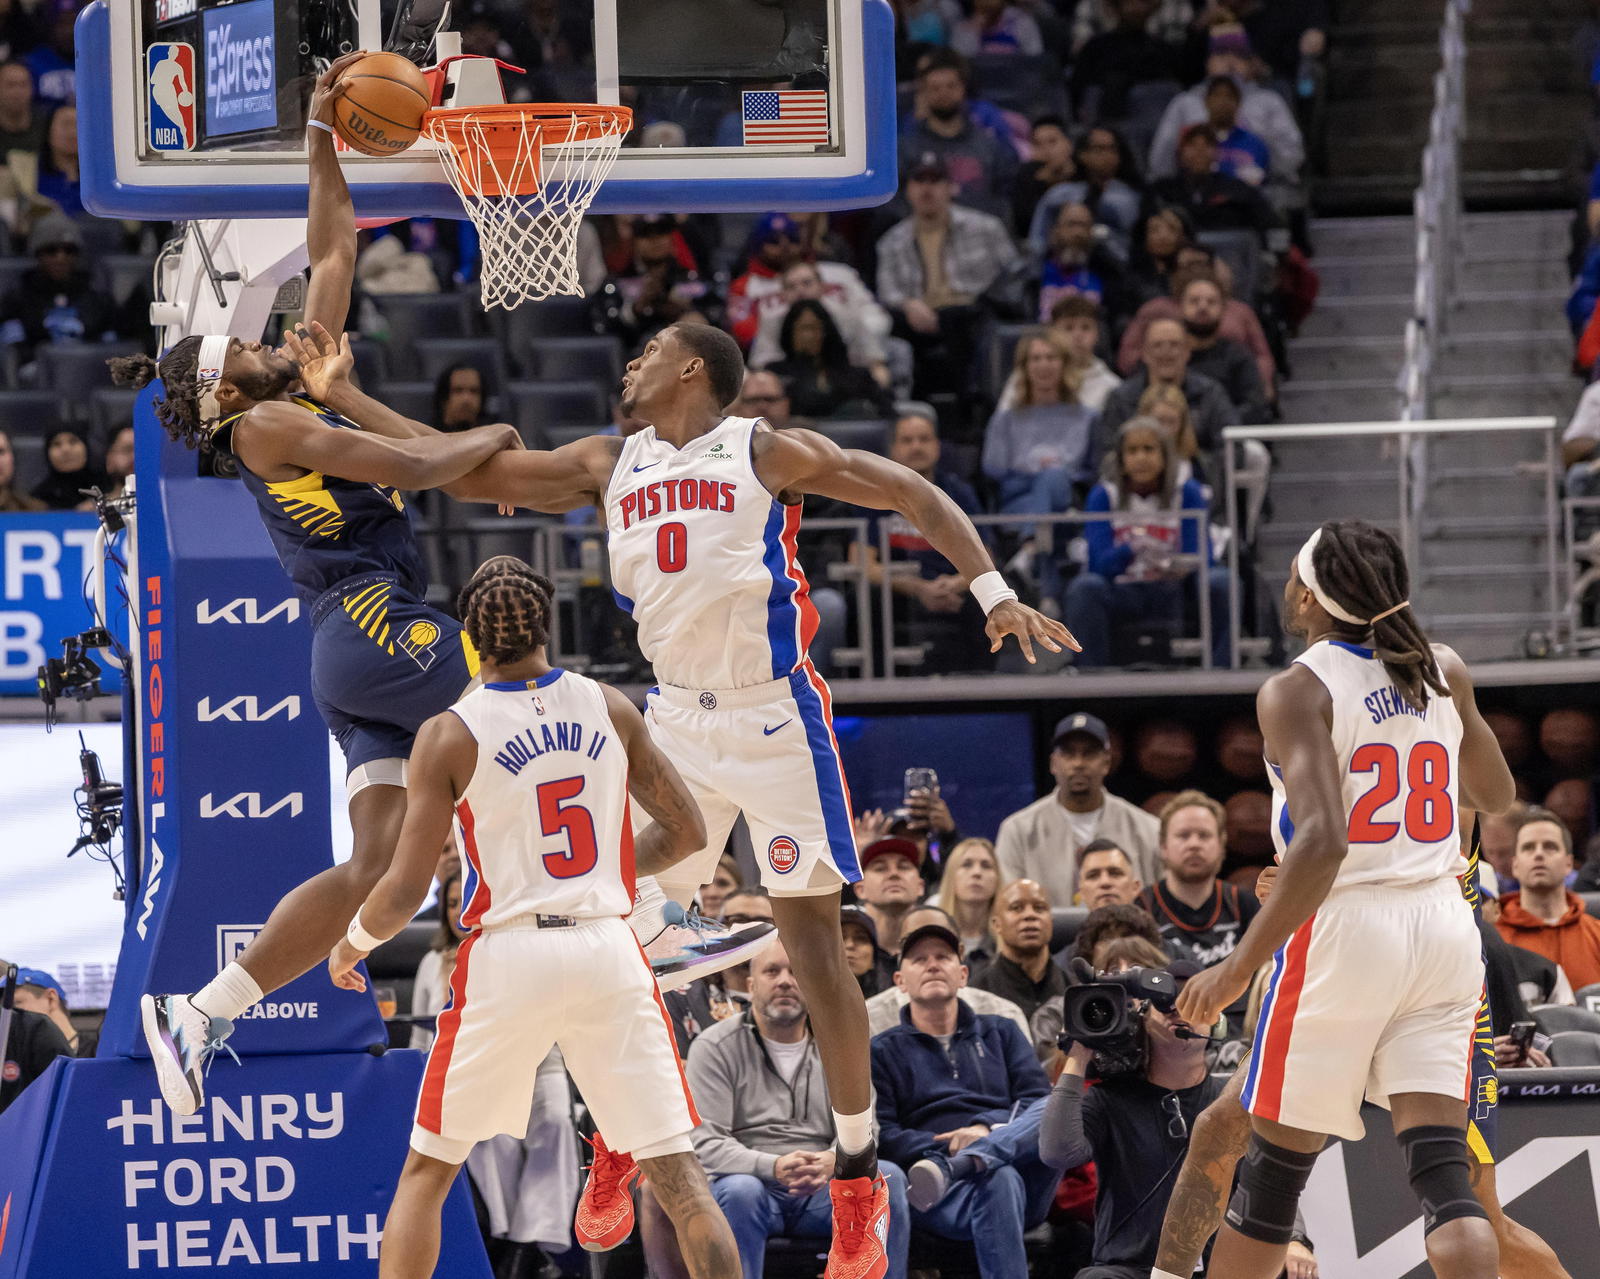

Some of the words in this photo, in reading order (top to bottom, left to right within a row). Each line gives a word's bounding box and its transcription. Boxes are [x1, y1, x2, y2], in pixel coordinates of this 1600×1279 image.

[155, 128, 178, 145] NBA
[349, 111, 409, 149] Wilson
[620, 479, 737, 531] PISTONS
[657, 522, 688, 573] 0
[147, 576, 164, 797] FIEGER
[1364, 685, 1432, 725] STEWA
[494, 722, 583, 776] HOLLAND
[587, 731, 607, 761] II
[1348, 741, 1454, 843] 28
[536, 774, 598, 880] 5
[136, 802, 165, 941] LAW
[107, 1092, 344, 1145] HENRY
[124, 1156, 296, 1207] FORD
[126, 1213, 384, 1269] HEALTH
